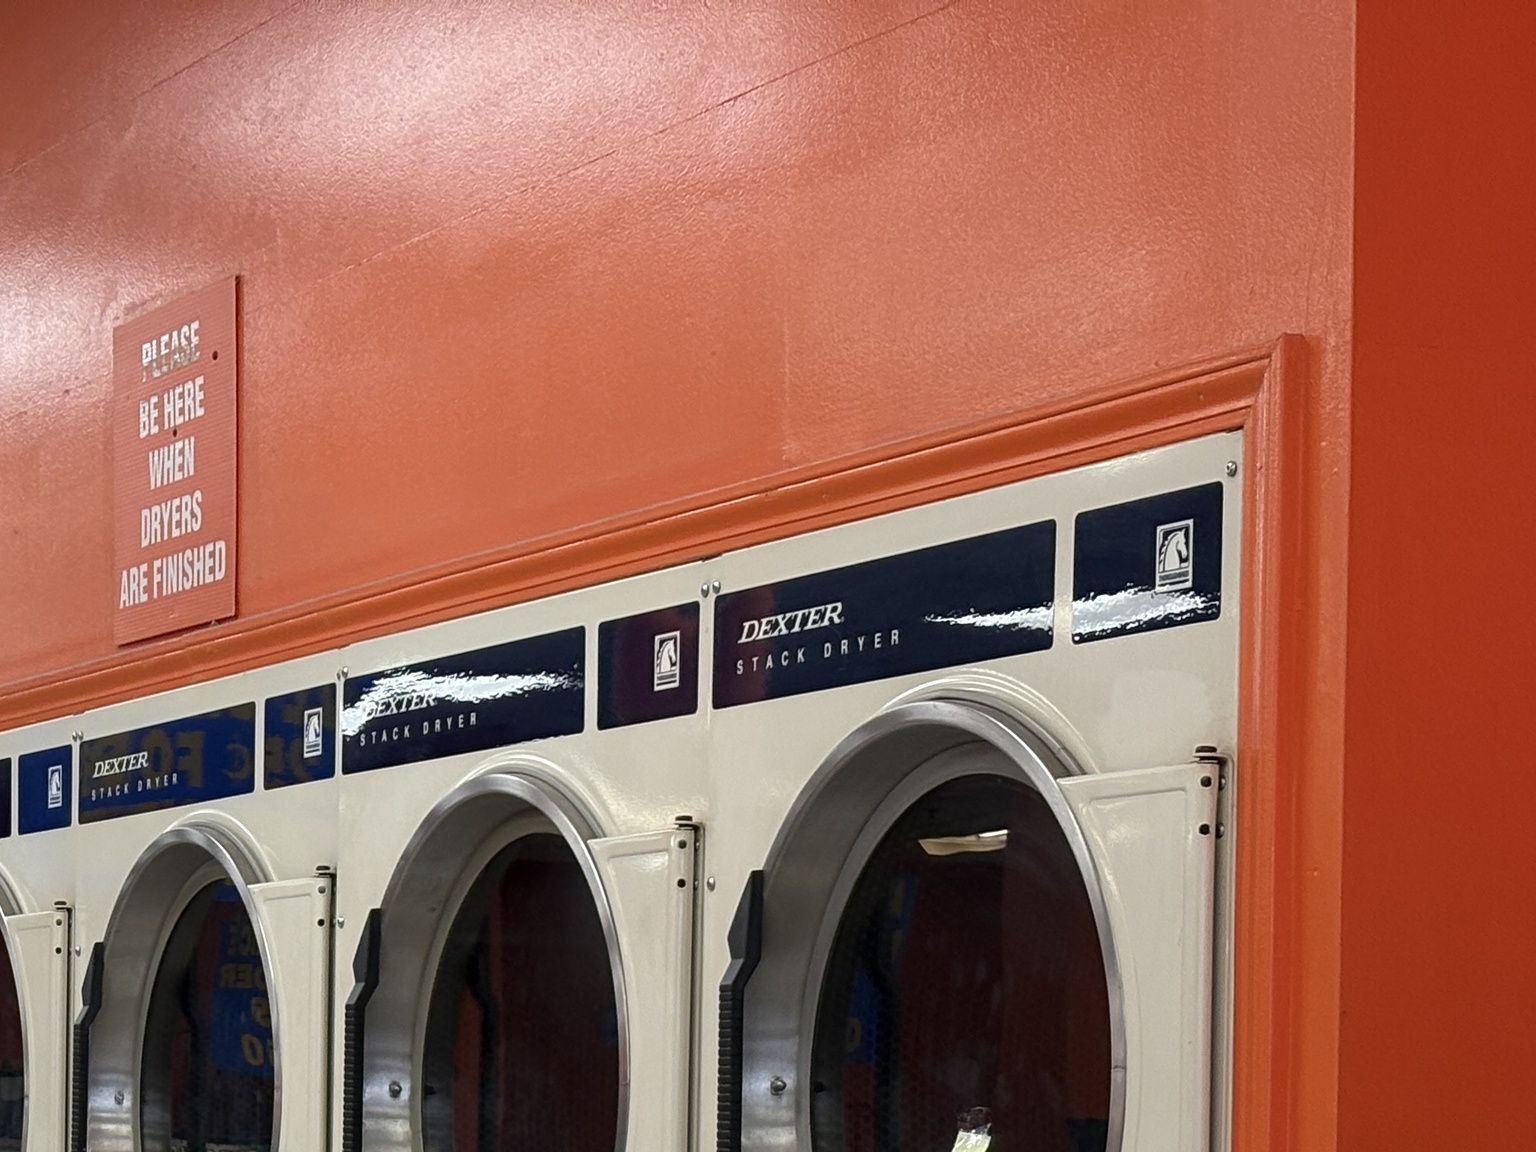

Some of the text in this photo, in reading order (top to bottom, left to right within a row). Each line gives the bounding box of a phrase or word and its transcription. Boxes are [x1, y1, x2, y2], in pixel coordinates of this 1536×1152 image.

[142, 320, 201, 382] PLEASE
[139, 375, 205, 439] BE HERE
[148, 436, 195, 490] WHEN
[141, 490, 202, 548] DRYERS
[119, 540, 227, 609] ARE FINISHED
[737, 602, 843, 644] DEXTER
[736, 629, 899, 675] STACK DRYER
[360, 712, 477, 746] STACK DRYER
[92, 751, 149, 778] DEXTER
[92, 773, 178, 801] STACK DRYER
